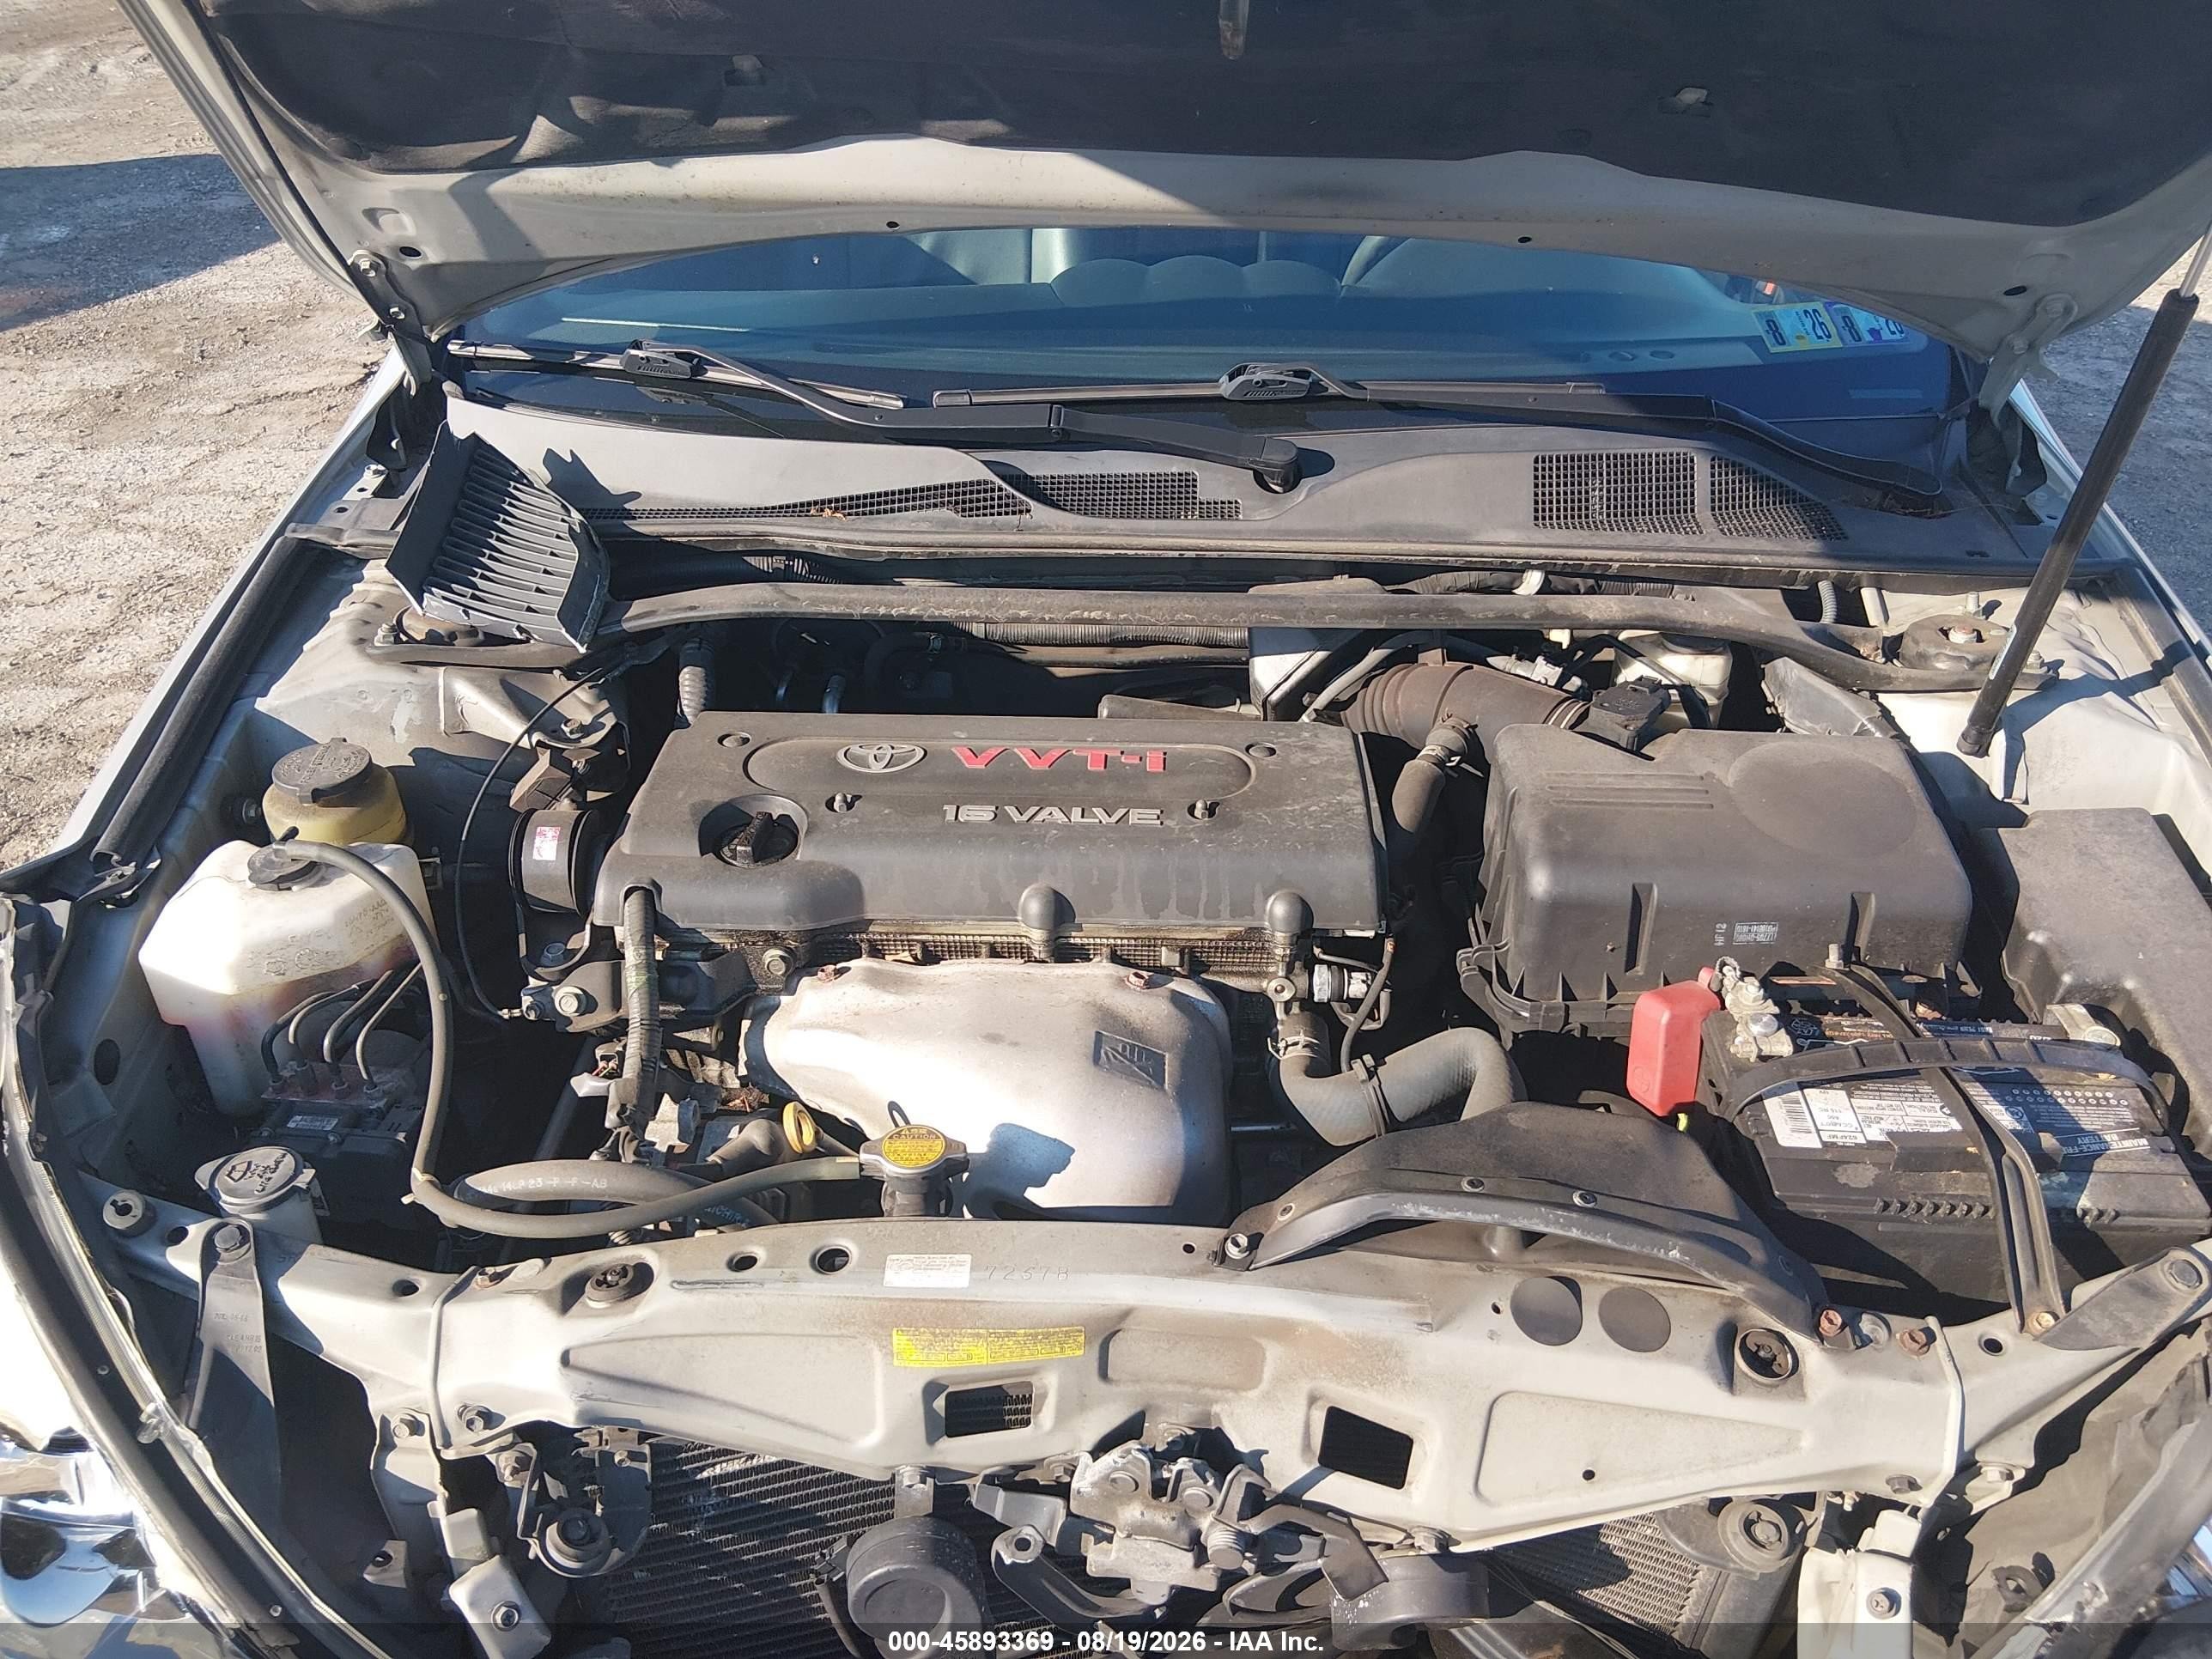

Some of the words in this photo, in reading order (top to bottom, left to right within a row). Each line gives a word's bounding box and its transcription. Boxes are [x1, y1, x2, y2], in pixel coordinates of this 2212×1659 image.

[943, 804, 1000, 823] 16
[1004, 804, 1164, 825] VALVE
[2076, 1133, 2118, 1145] BATTERY
